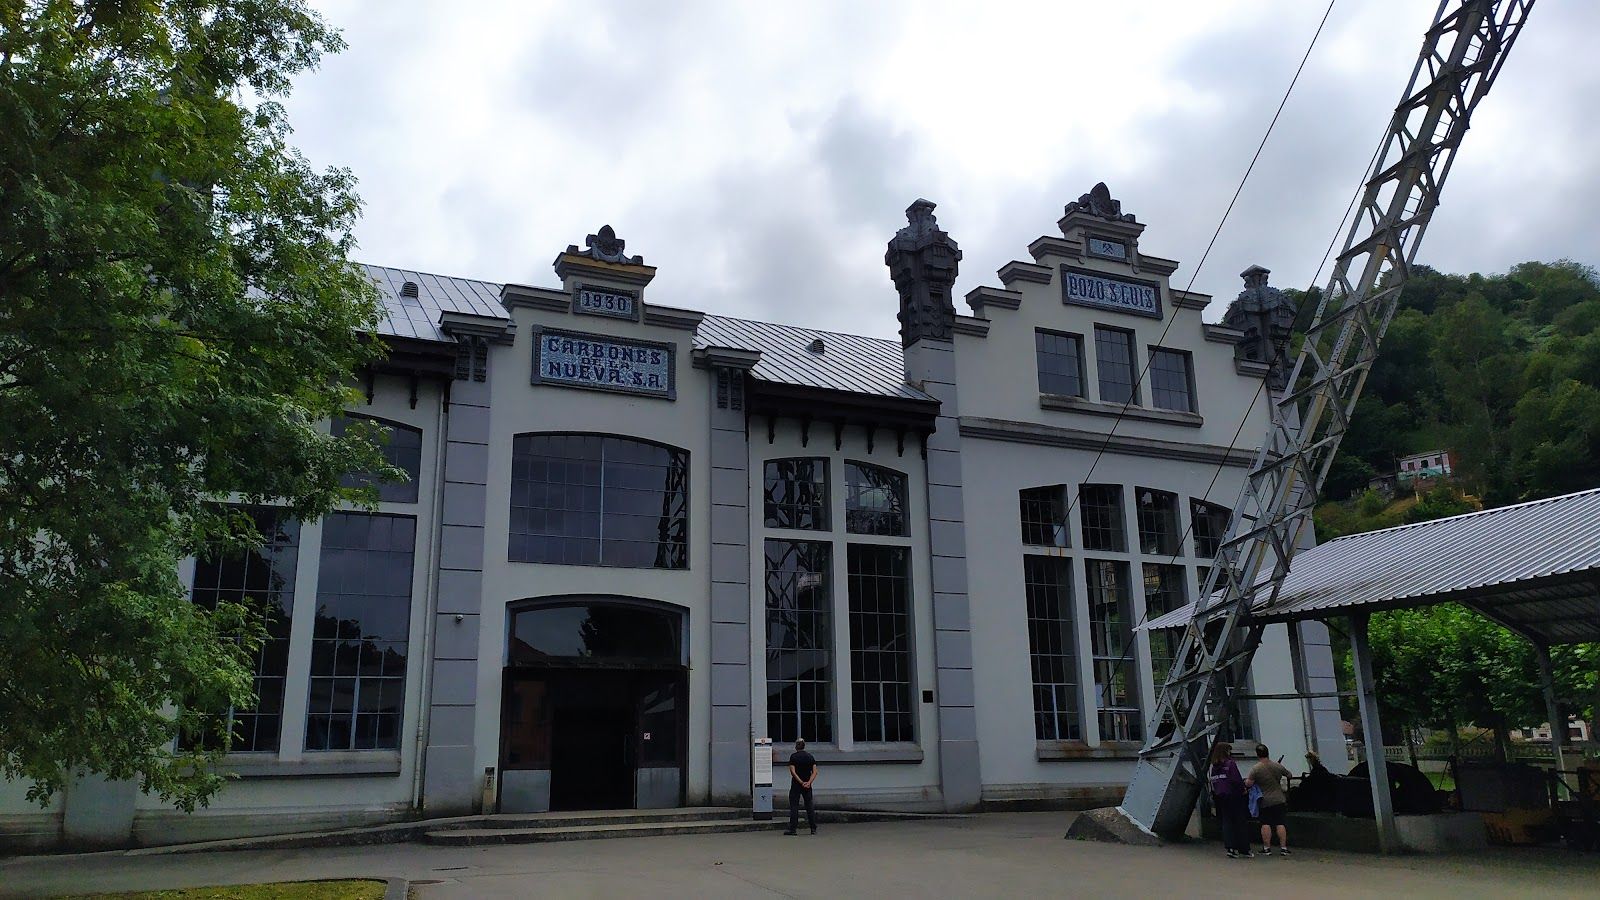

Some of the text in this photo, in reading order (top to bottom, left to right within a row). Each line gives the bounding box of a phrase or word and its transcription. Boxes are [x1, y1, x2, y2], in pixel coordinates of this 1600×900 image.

[1068, 275, 1105, 300] POZO
[583, 292, 627, 311] 1930
[547, 338, 661, 365] CARBONES
